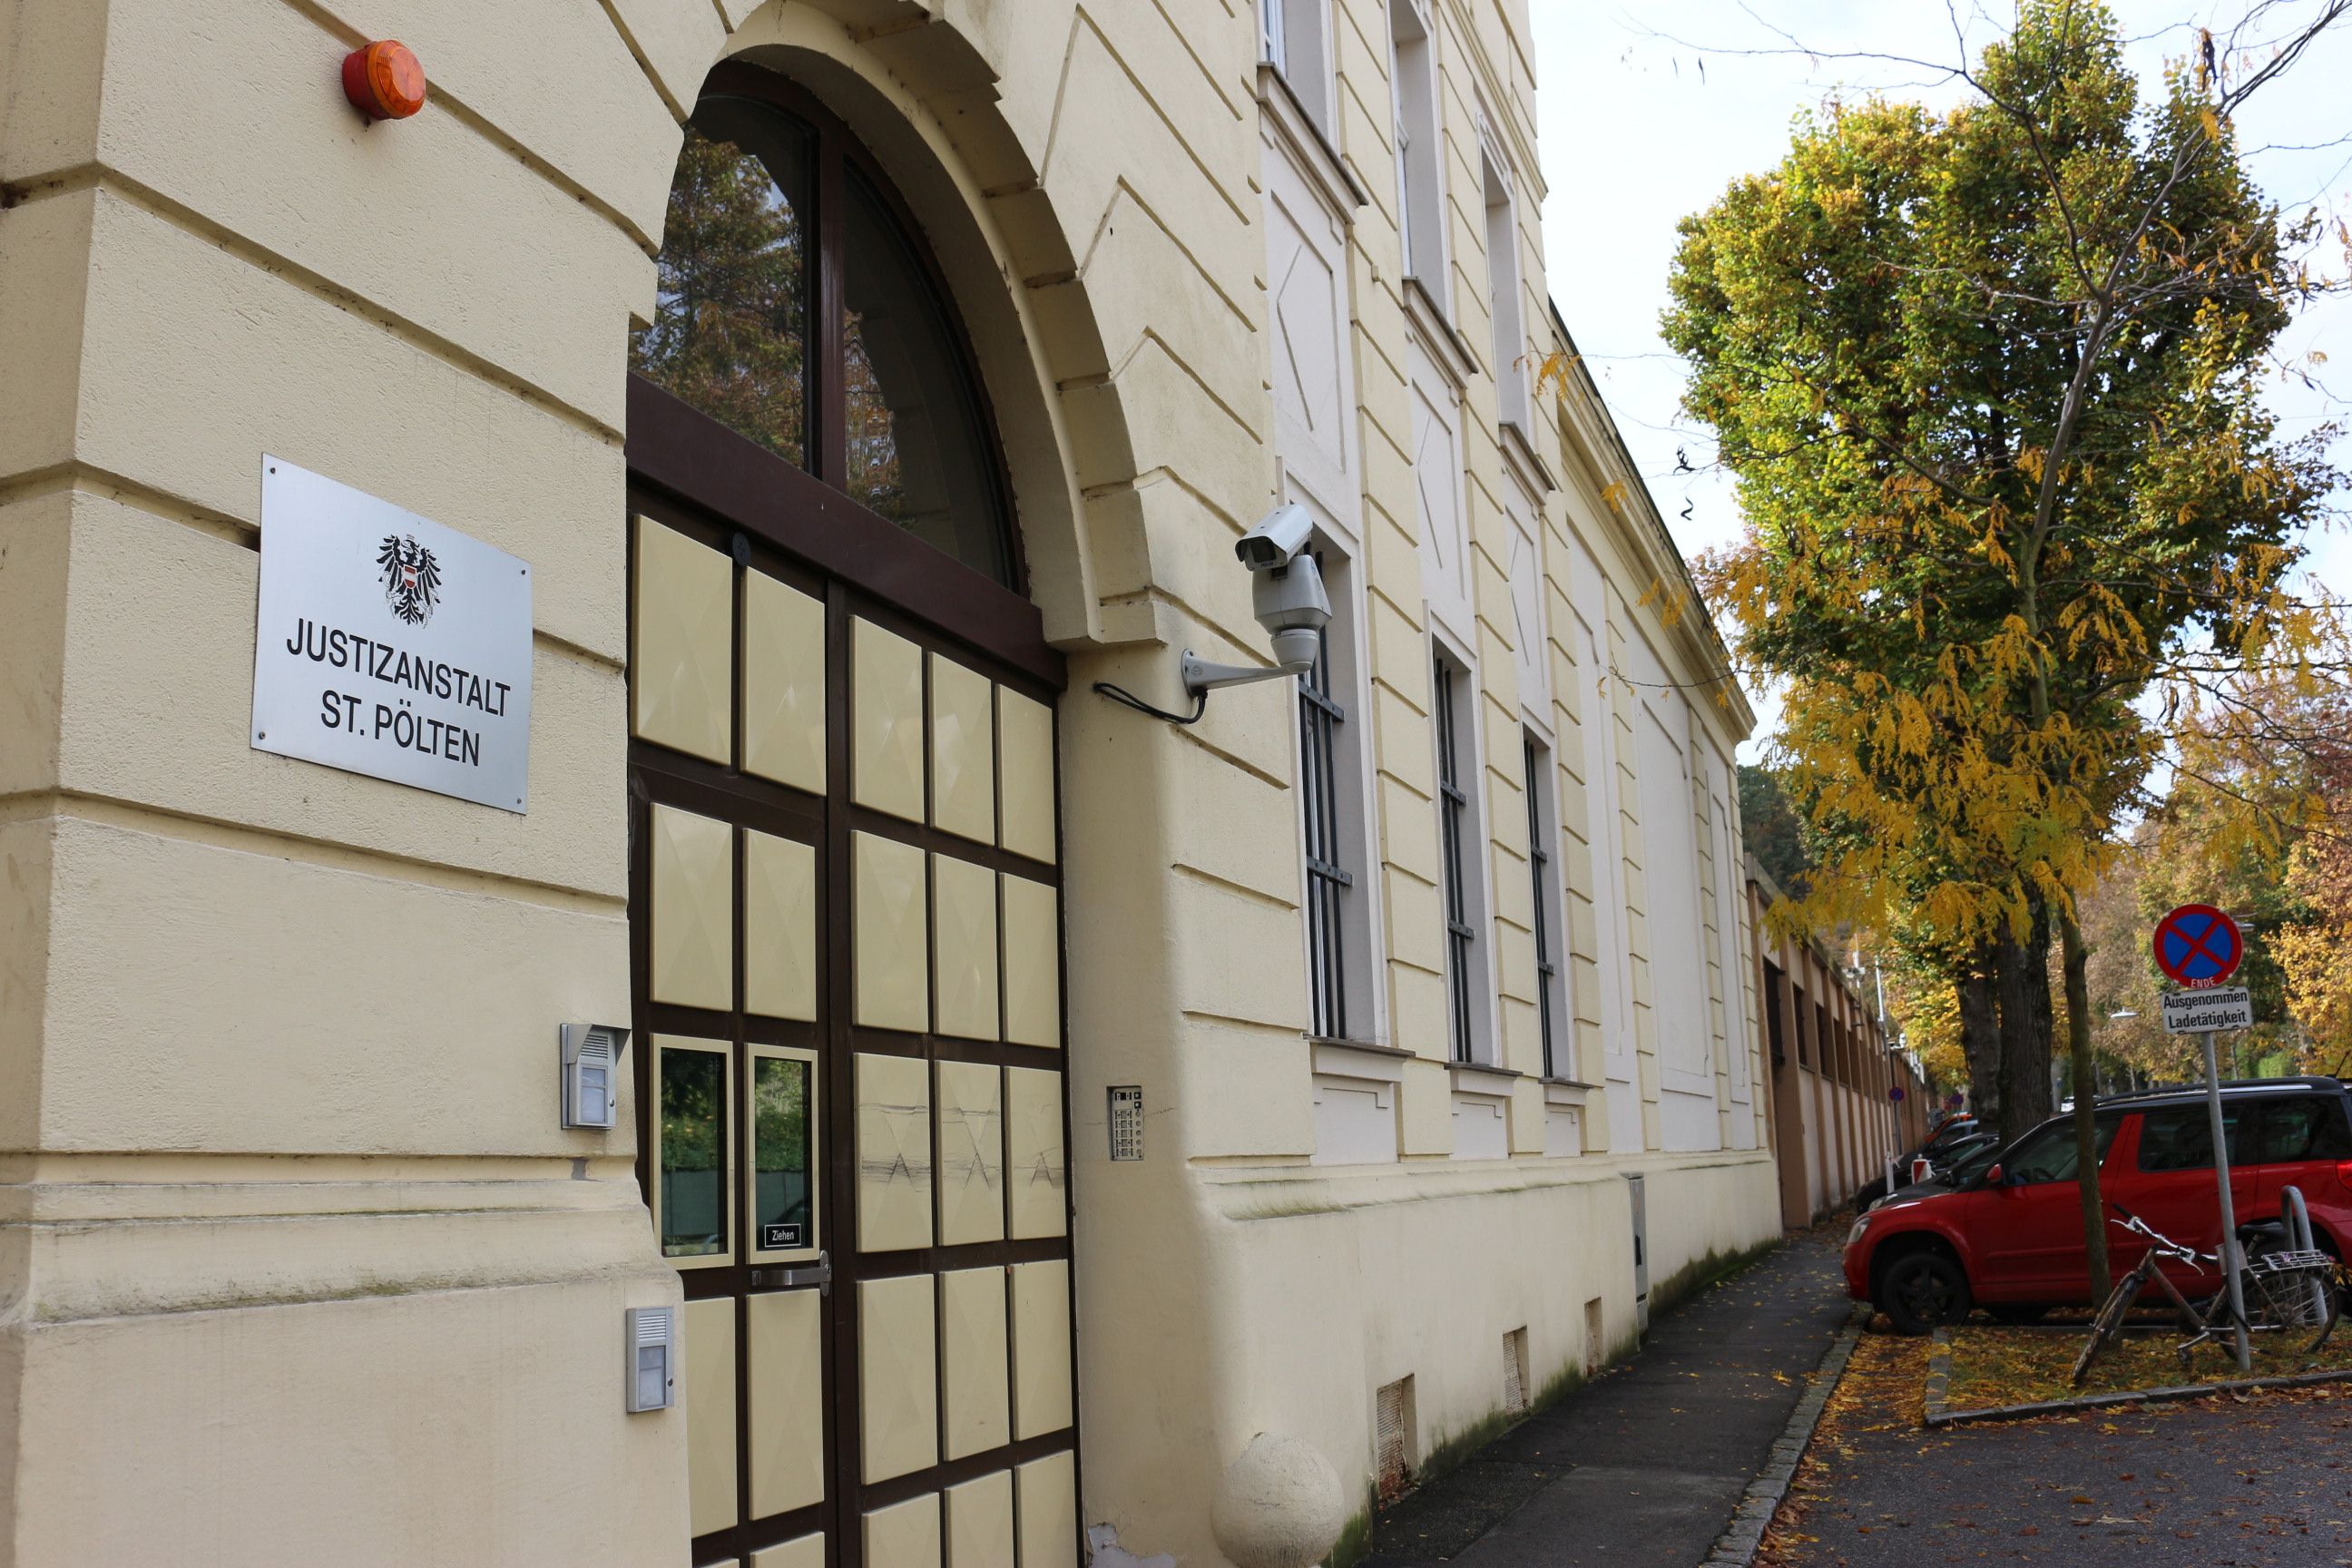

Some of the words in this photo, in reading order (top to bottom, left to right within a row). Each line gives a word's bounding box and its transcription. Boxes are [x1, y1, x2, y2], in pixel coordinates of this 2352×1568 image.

[286, 618, 511, 717] JUSTIZANSTALT
[320, 690, 365, 736] ST.
[375, 699, 480, 767] PÖLTEN
[2190, 977, 2217, 988] ENDE
[2163, 992, 2248, 1010] Ausgenommen
[2168, 1009, 2248, 1029] Ladetätigkeit
[771, 1230, 795, 1241] Ziehen
